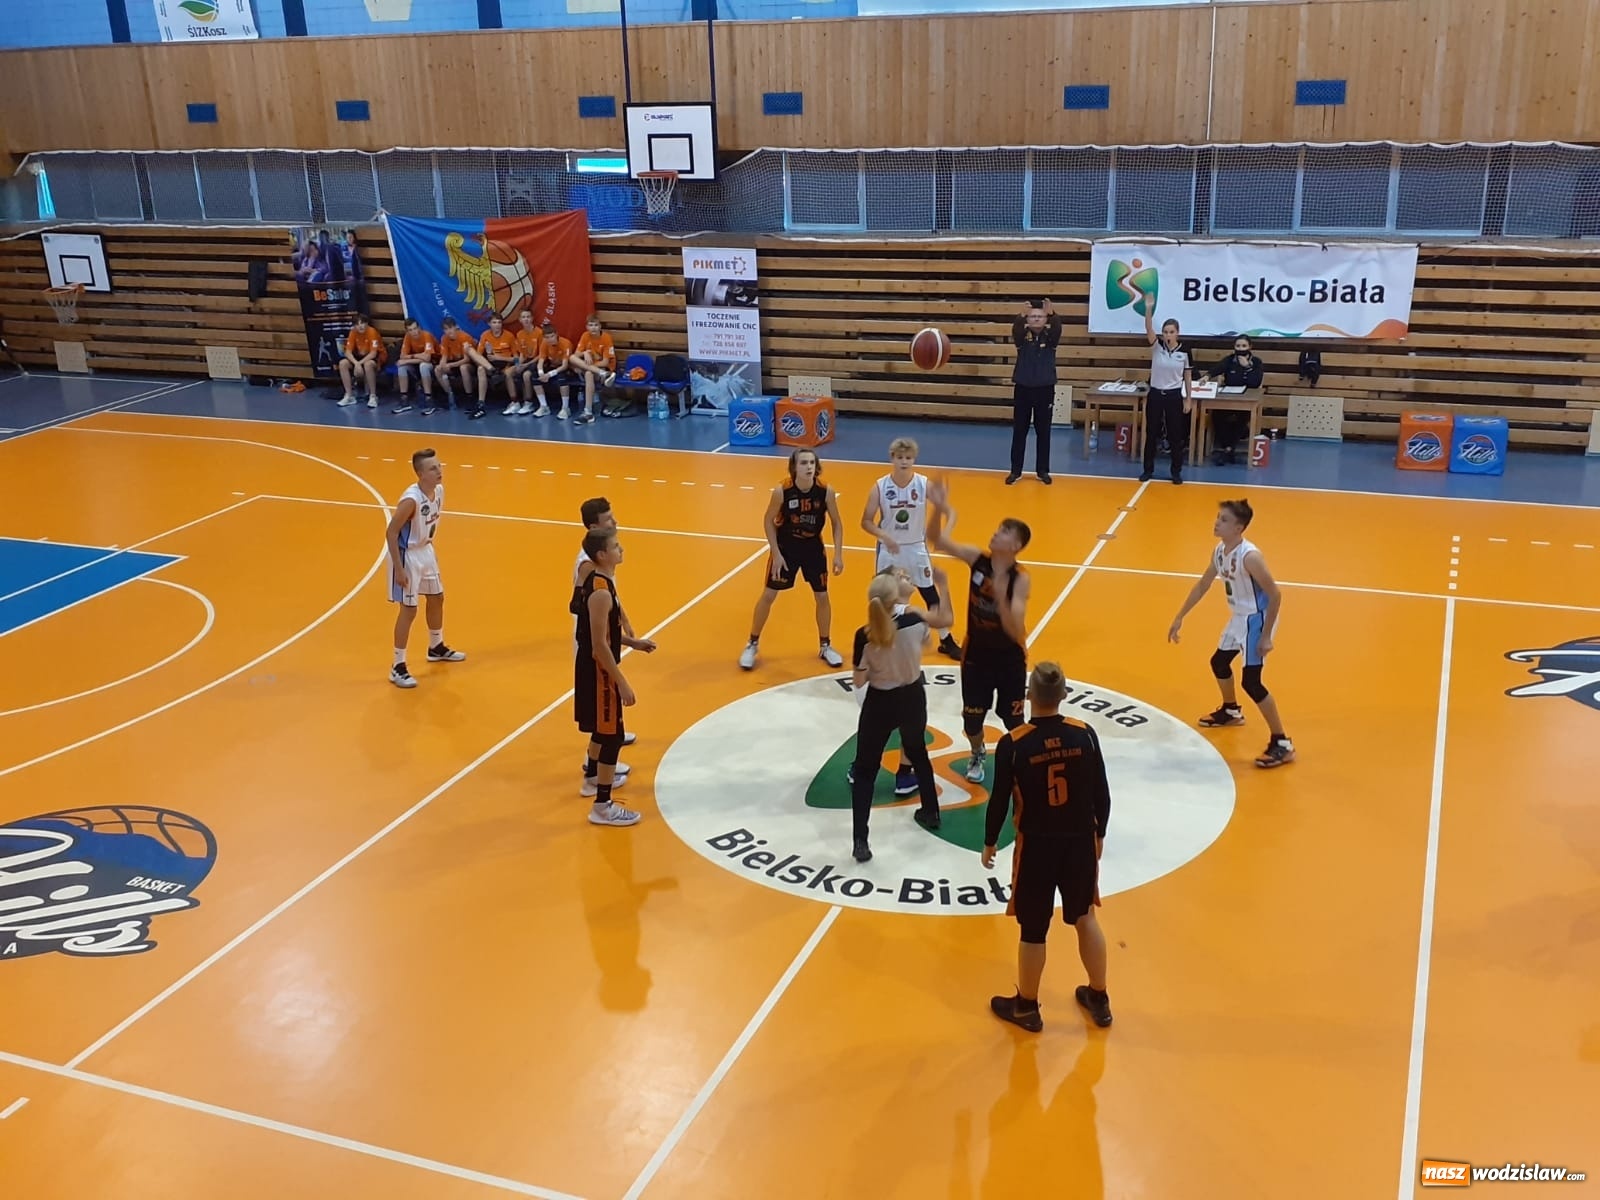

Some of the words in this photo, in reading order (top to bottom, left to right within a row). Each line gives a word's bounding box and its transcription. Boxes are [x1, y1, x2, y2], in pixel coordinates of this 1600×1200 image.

[692, 259, 738, 270] PIKMET
[1183, 276, 1386, 304] Bielsko-Biała
[706, 312, 740, 321] TOCZENIE
[695, 321, 740, 330] FREZOWANIE
[742, 322, 757, 330] CNC
[1117, 427, 1129, 445] 5
[1252, 441, 1266, 461] 5
[910, 488, 919, 501] 6
[800, 500, 812, 511] 15
[923, 566, 931, 577] 6
[1047, 762, 1068, 806] 5
[705, 830, 1013, 906] Bielsko-Biał
[126, 876, 187, 895] BASKET
